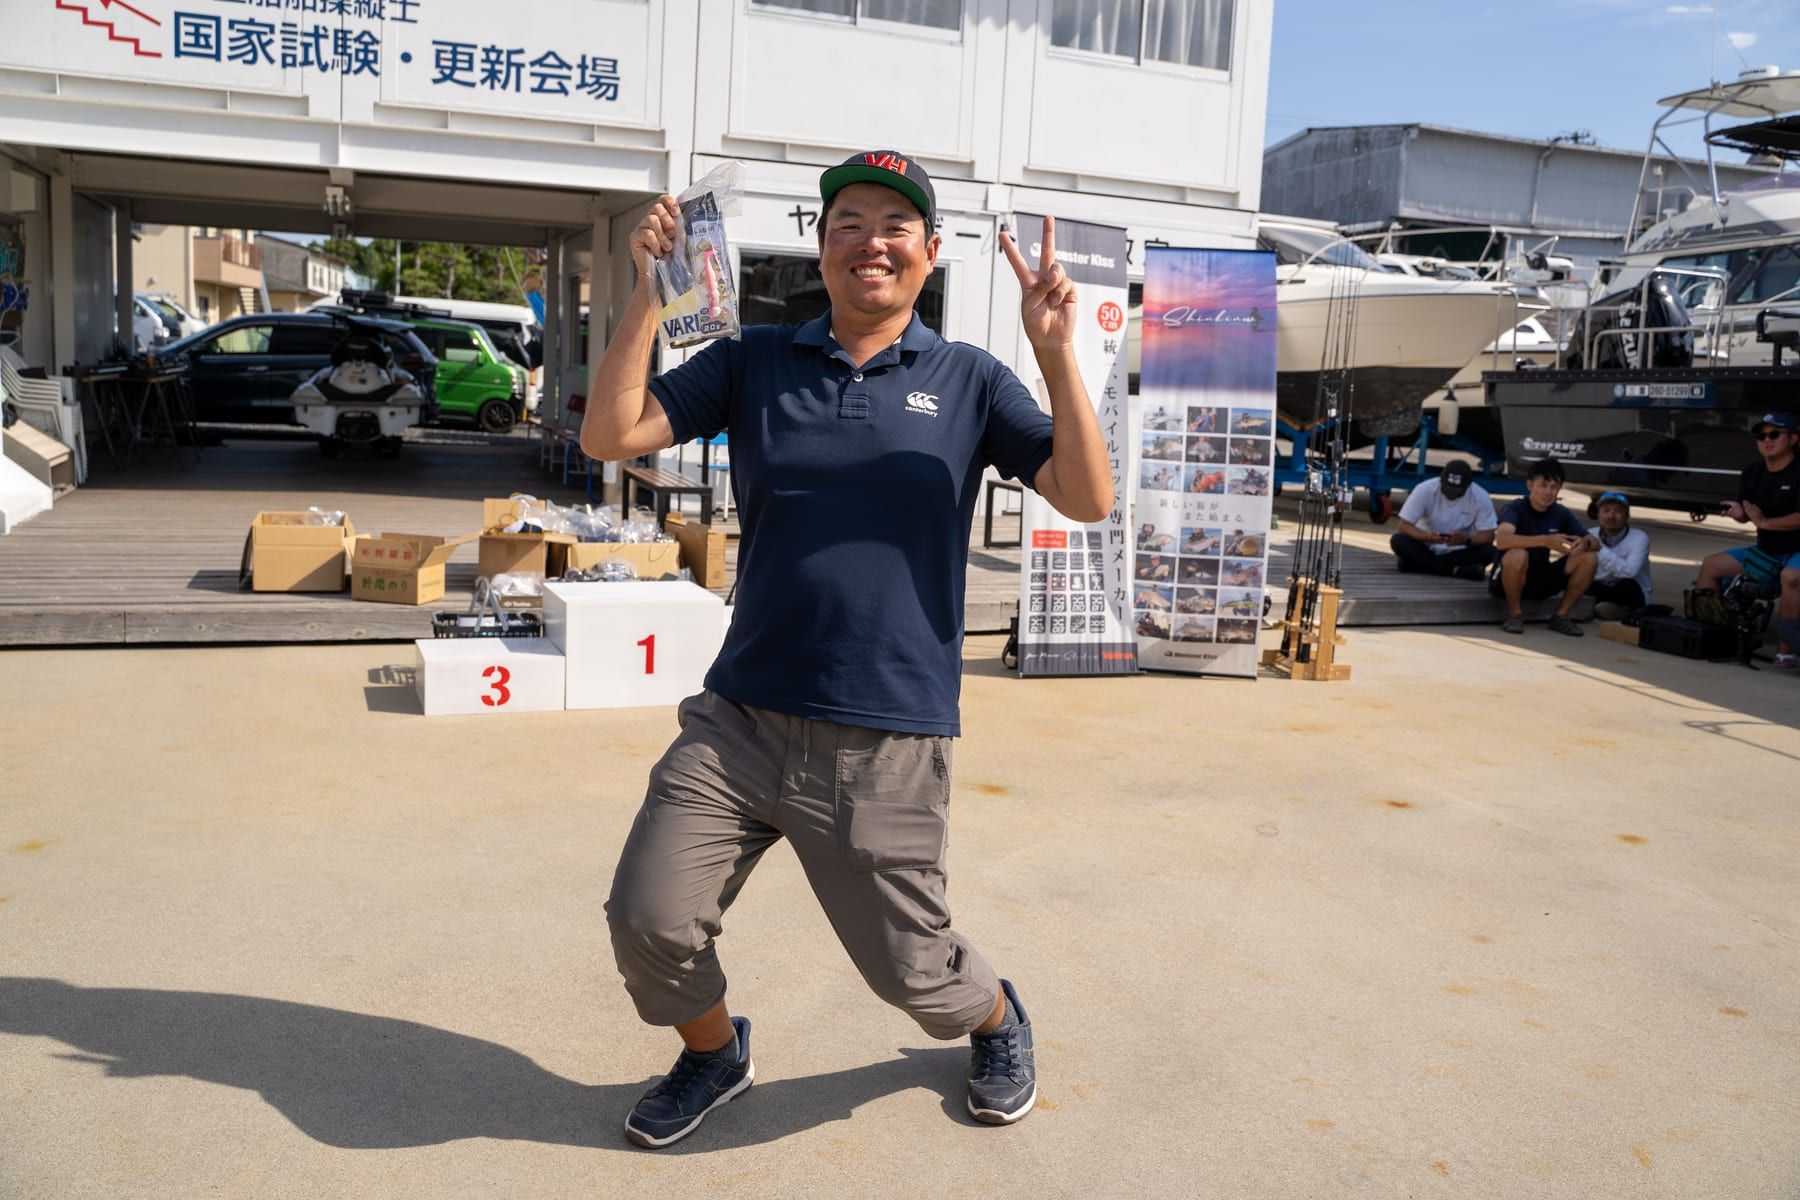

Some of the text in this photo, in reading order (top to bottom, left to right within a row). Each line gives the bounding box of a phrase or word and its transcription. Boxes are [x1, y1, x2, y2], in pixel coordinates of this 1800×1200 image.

[173, 11, 621, 101] 国家試験・更新会場
[864, 152, 908, 176] VH
[1055, 249, 1115, 268] onster Kiss
[1100, 306, 1120, 321] 50
[636, 634, 656, 675] 1
[480, 665, 512, 706] 3
